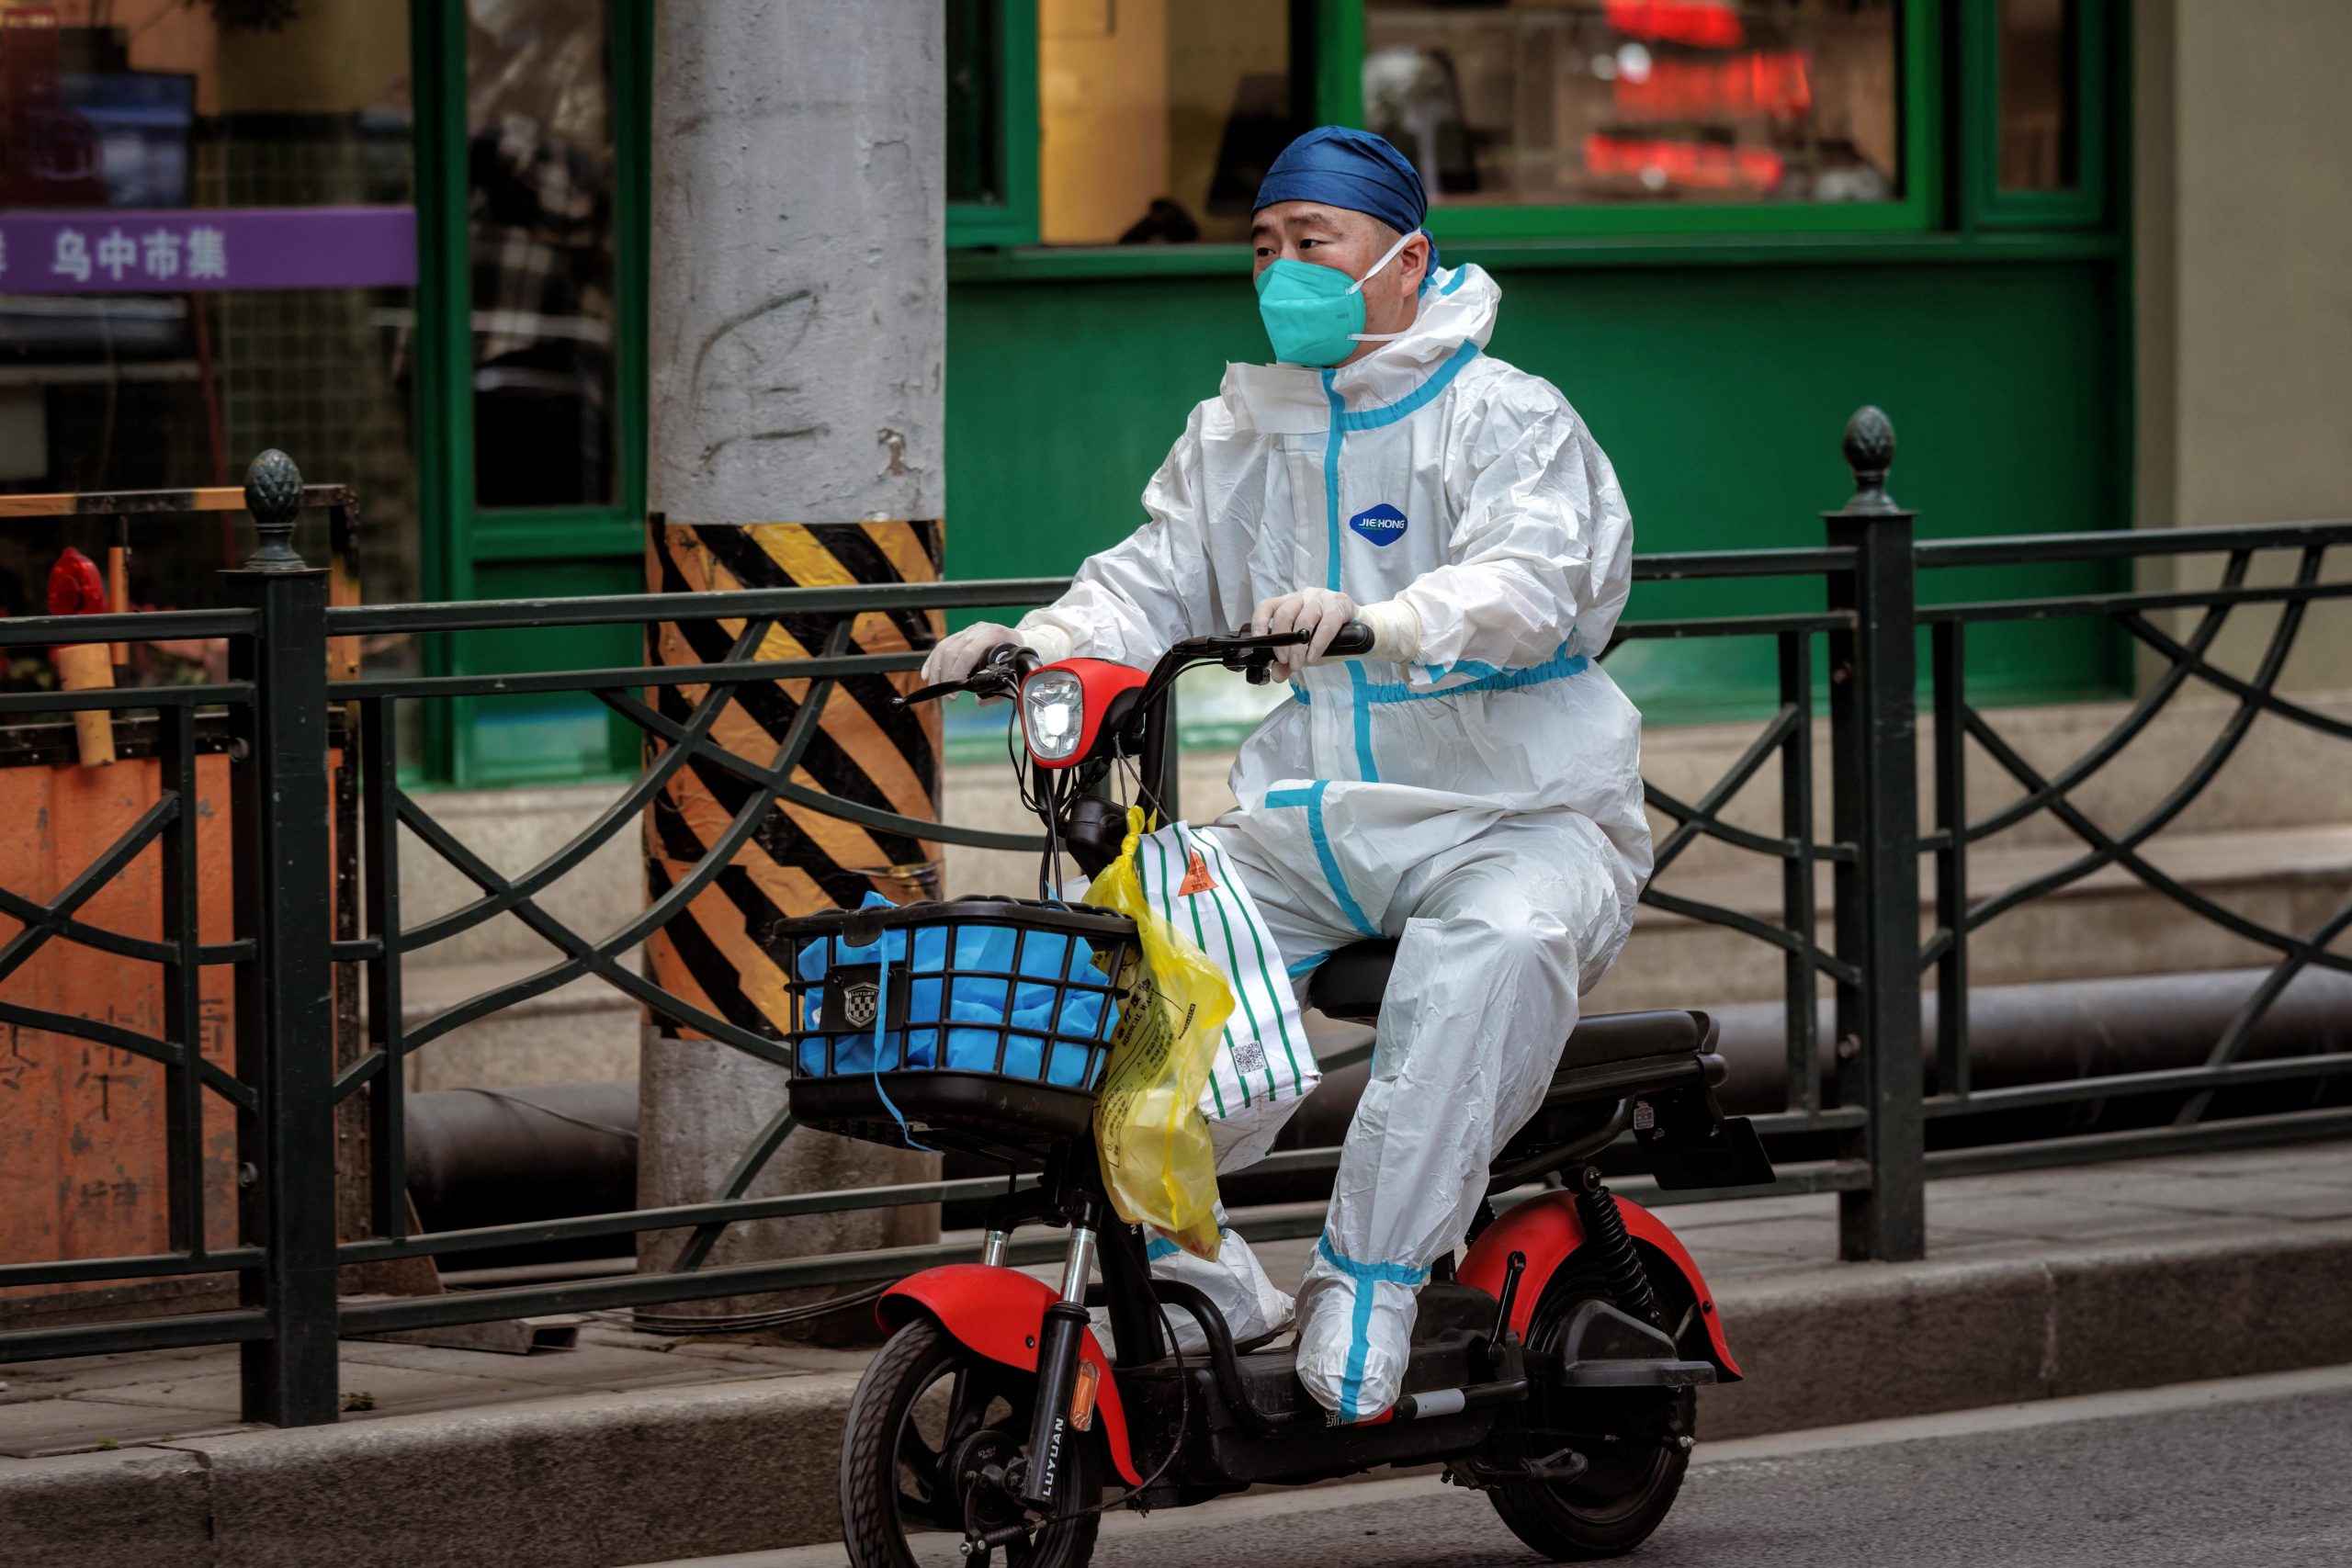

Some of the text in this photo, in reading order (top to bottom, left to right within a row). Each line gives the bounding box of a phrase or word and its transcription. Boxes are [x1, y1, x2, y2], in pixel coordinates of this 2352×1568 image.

[52, 228, 228, 281] 乌中市集
[1122, 1013, 1143, 1046] MEDICAL
[1043, 1417, 1065, 1497] LUYUAN
